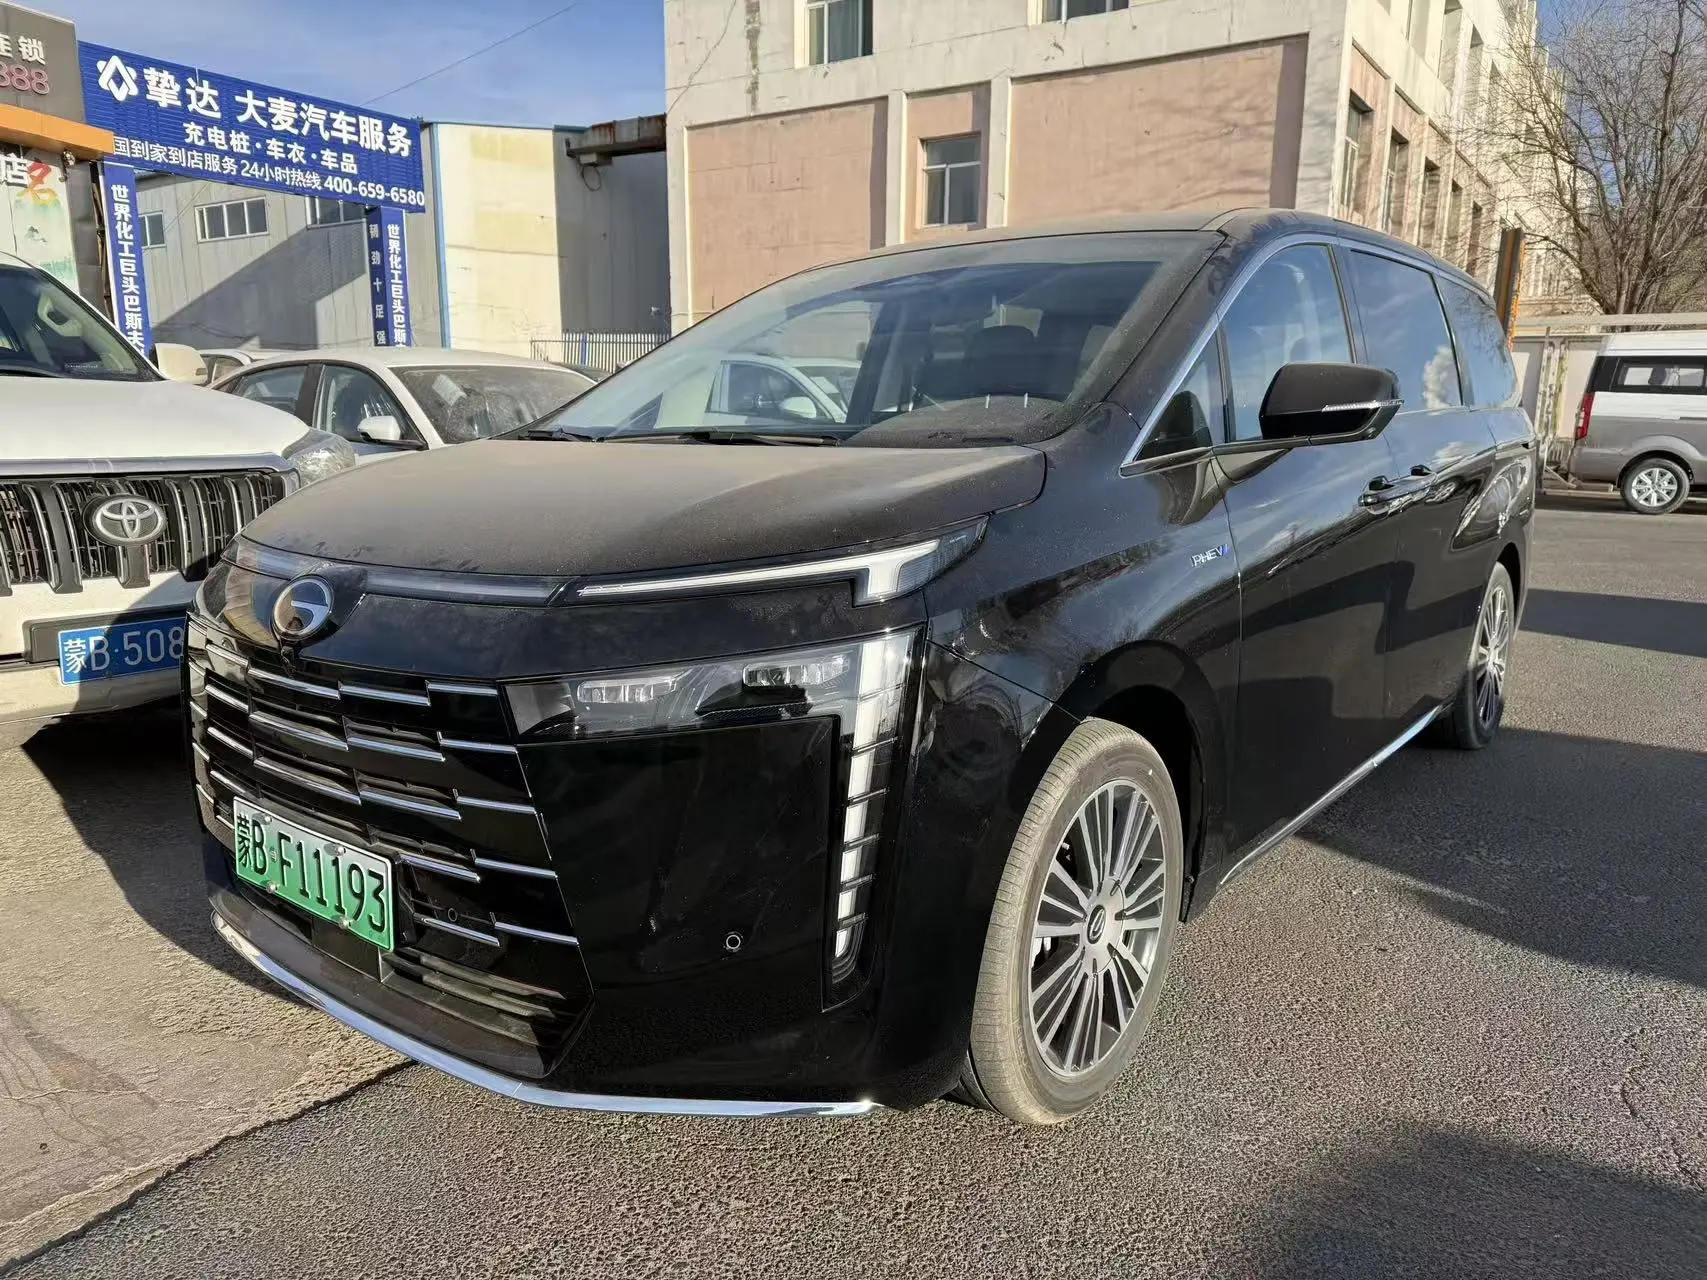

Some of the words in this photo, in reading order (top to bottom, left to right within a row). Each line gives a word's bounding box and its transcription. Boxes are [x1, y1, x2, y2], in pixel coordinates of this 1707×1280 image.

[143, 67, 221, 118] 挚达
[235, 90, 412, 157] 大麦汽车服务
[324, 176, 425, 206] 400-659-6580
[111, 184, 145, 354] 世界化工巨头巴斯夫
[387, 223, 407, 347] 世界化工巨头巴斯
[1191, 544, 1228, 567] PHEV
